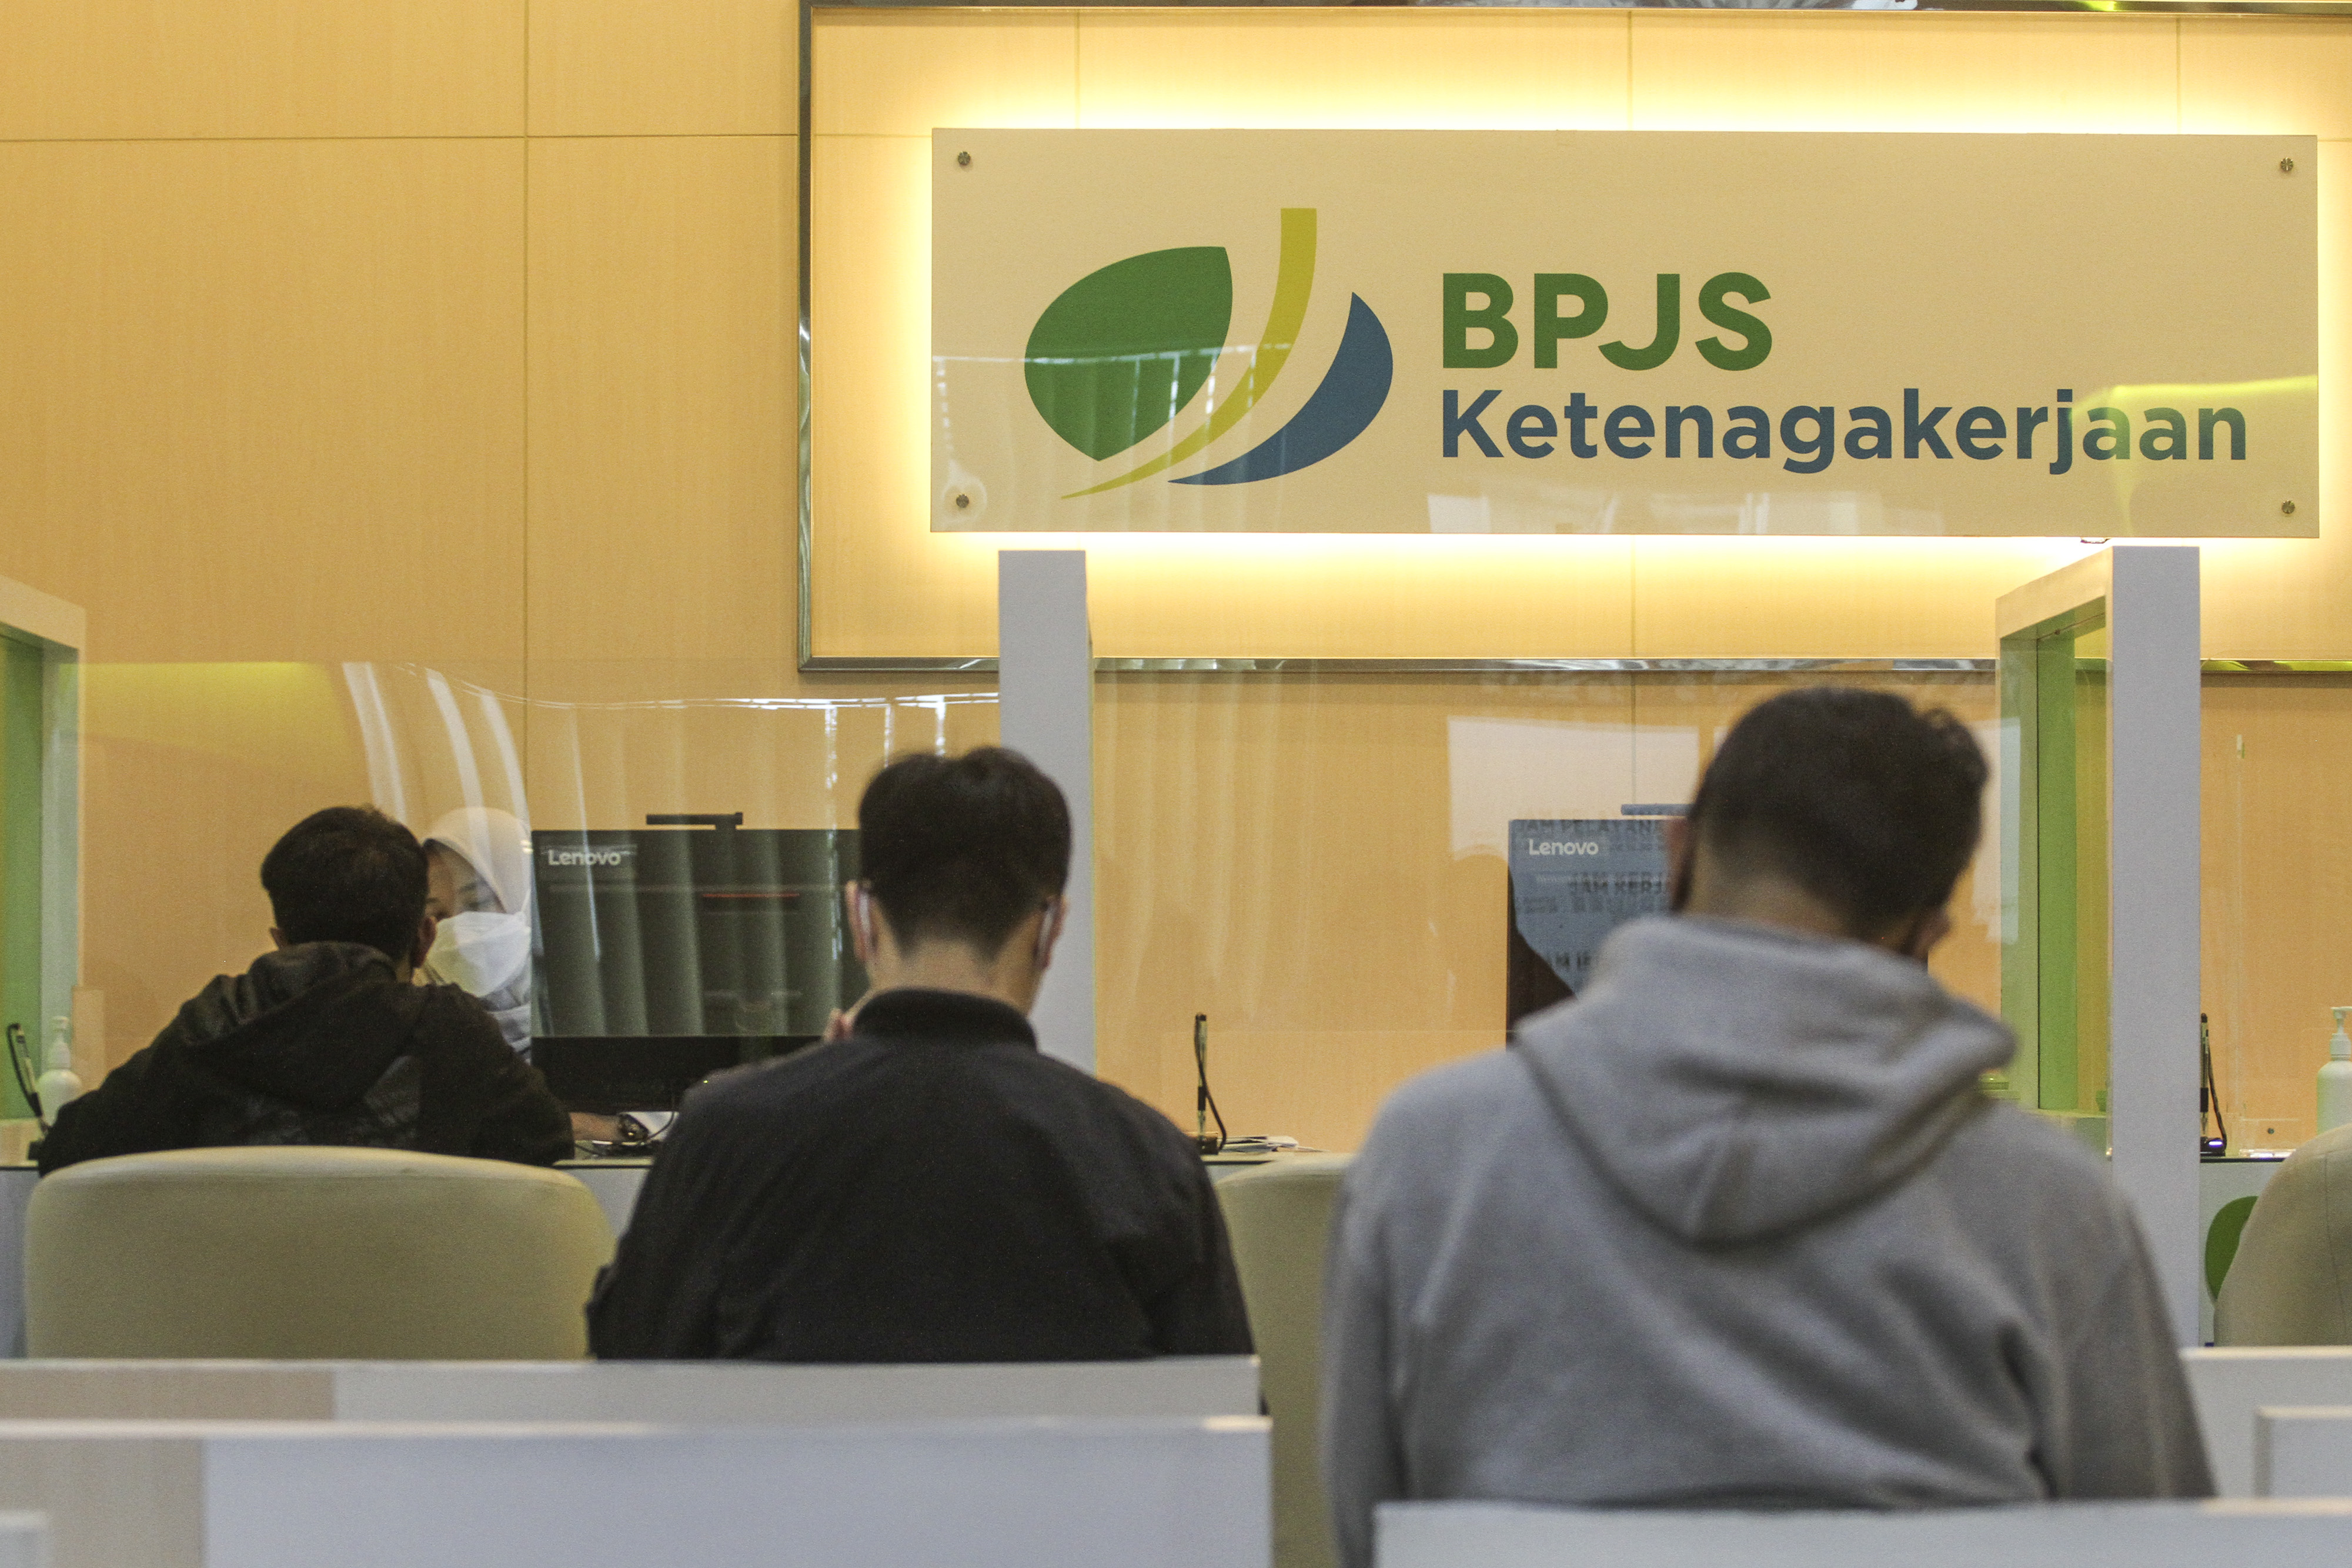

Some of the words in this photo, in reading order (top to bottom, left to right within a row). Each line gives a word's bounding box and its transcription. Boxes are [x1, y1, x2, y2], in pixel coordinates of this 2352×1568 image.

[1442, 272, 1772, 371] BPJS
[1442, 388, 2246, 475] Ketenagakerjaan
[548, 849, 622, 865] Lenovo
[1529, 838, 1599, 855] Lenovo
